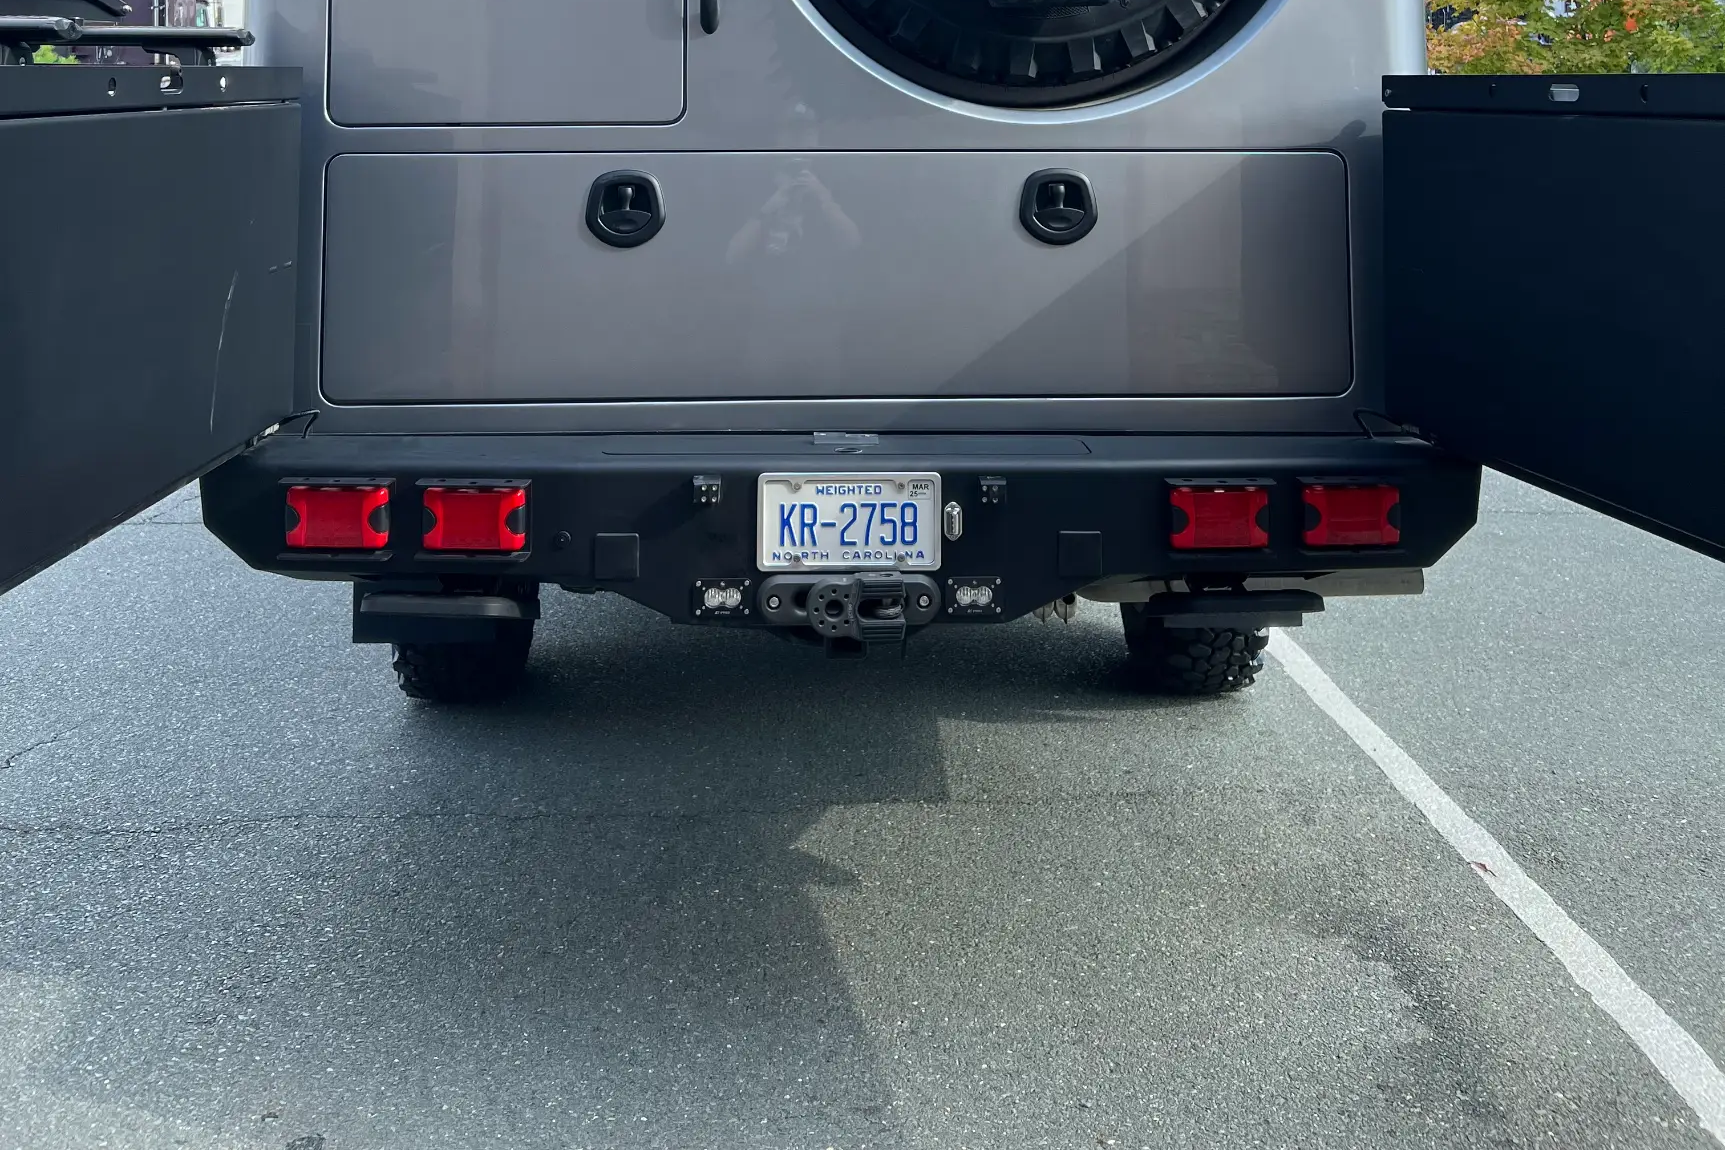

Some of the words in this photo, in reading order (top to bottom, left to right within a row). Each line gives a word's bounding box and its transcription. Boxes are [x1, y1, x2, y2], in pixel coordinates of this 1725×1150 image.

[815, 484, 883, 496] WEIGHTED
[912, 483, 930, 491] MAR
[779, 501, 919, 548] KR-2758
[771, 551, 830, 562] NORTH
[842, 550, 925, 561] CAROLINA
